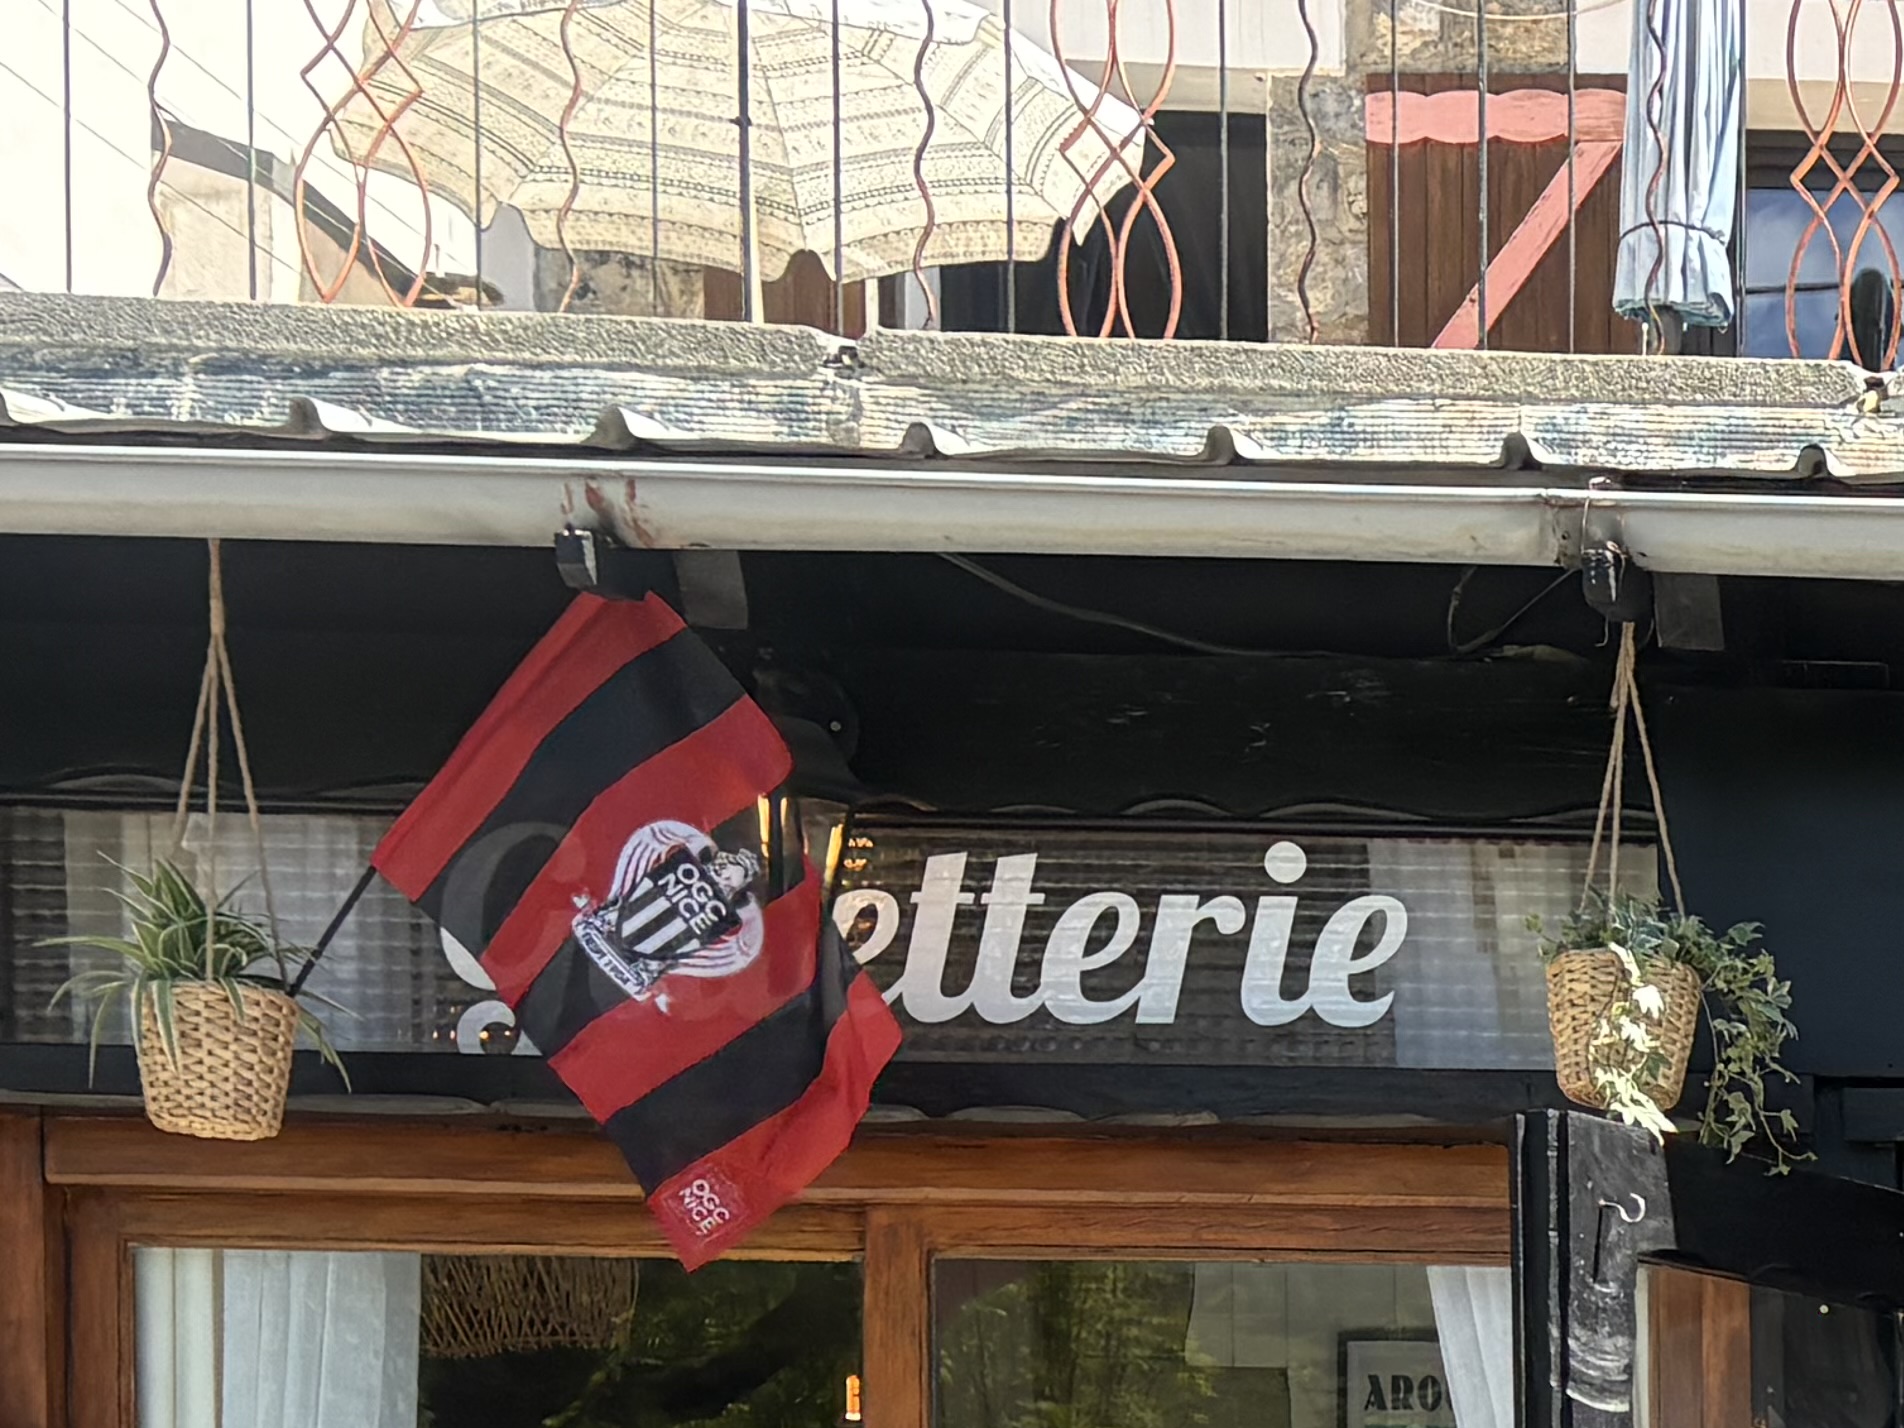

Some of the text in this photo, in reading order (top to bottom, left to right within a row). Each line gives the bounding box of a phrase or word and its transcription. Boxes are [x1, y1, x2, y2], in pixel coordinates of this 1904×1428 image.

[657, 872, 714, 936] NICE
[675, 861, 728, 927] OGC
[679, 1186, 716, 1236] NICE
[691, 1178, 730, 1225] OGC
[1364, 1373, 1453, 1412] ARO
